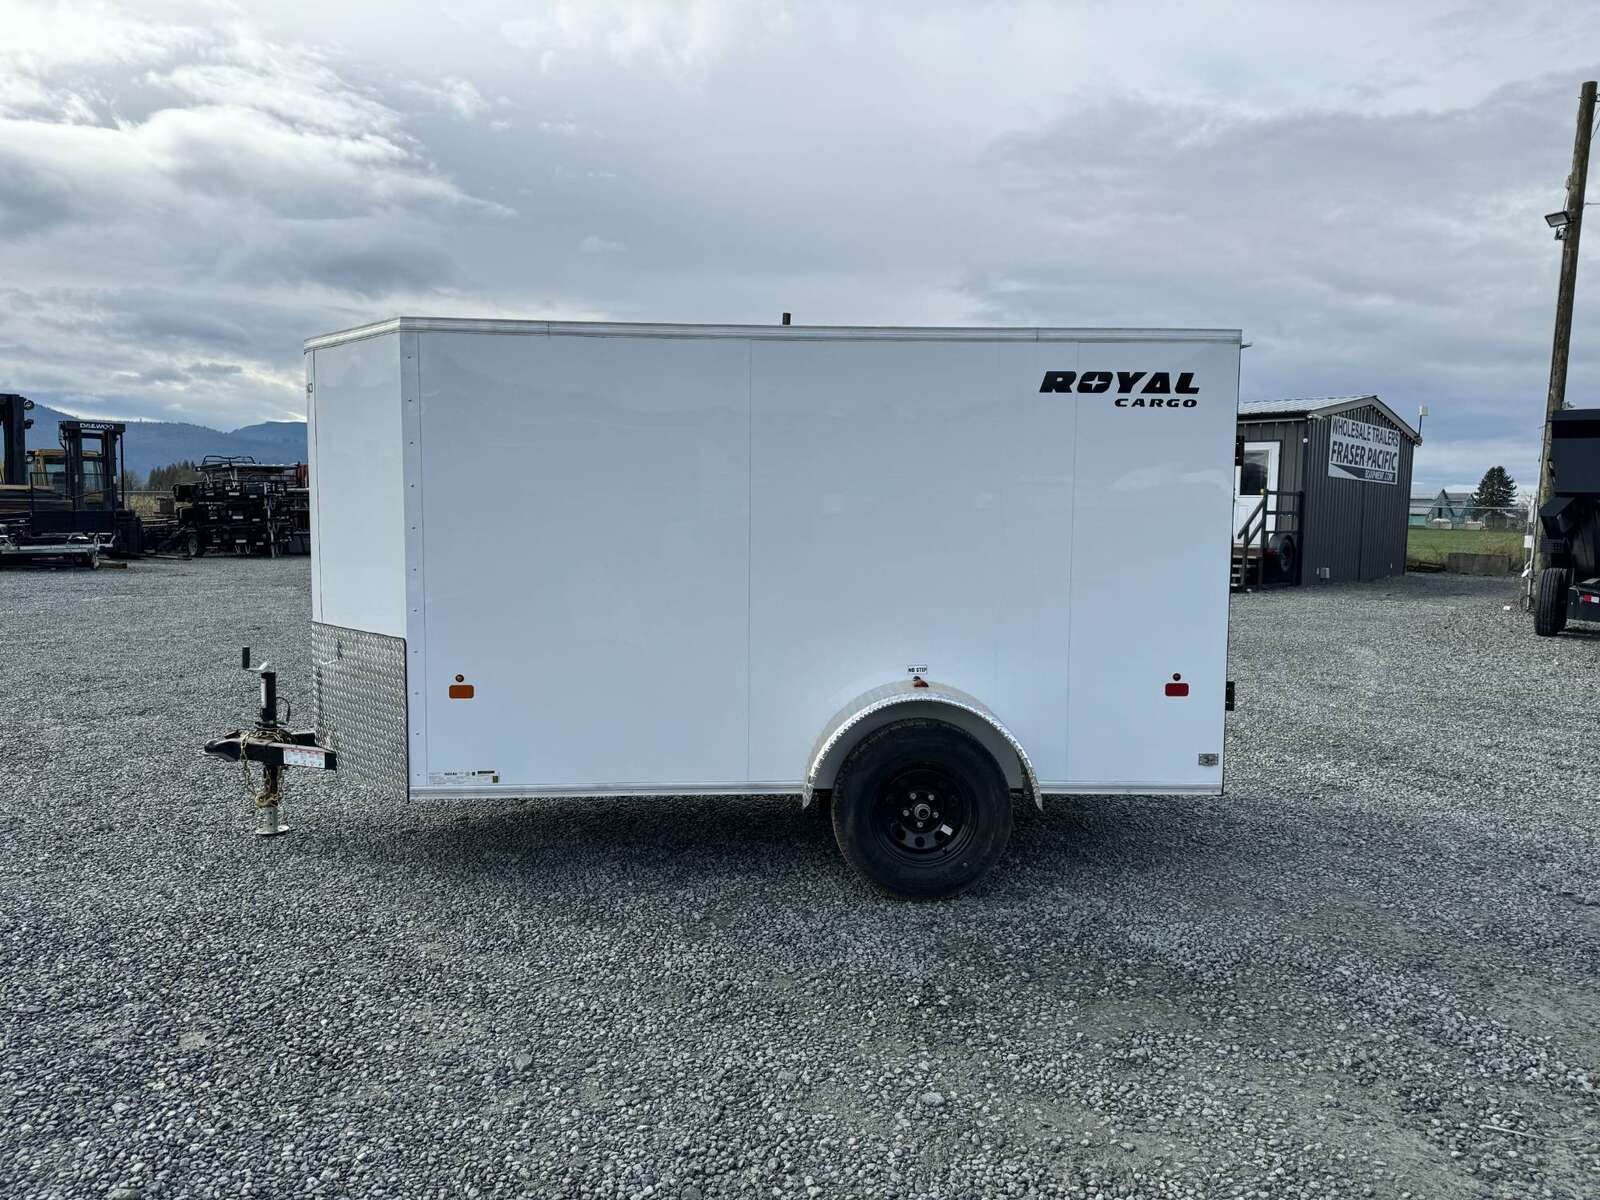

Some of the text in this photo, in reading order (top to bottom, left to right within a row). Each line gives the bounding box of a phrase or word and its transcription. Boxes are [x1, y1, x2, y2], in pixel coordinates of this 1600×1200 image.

[1039, 371, 1199, 394] ROYAL
[1114, 398, 1198, 408] CARGO
[1332, 418, 1399, 447] WHOLESALE TRAILERS
[1330, 441, 1398, 471] FRASER PACIFIC
